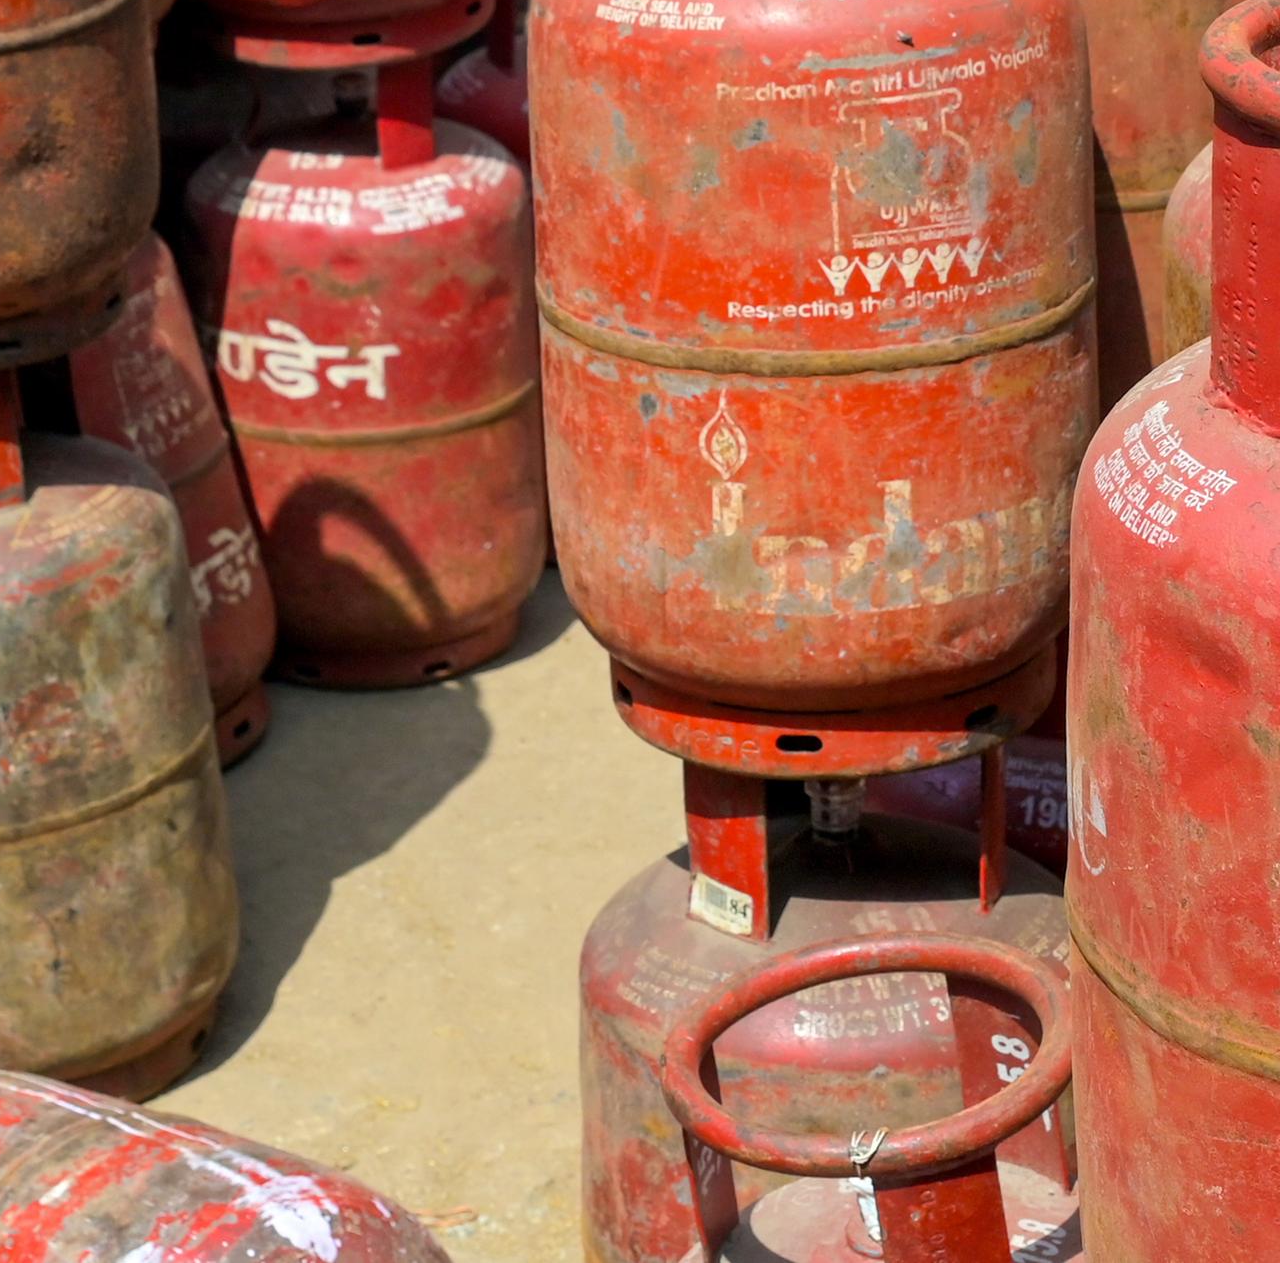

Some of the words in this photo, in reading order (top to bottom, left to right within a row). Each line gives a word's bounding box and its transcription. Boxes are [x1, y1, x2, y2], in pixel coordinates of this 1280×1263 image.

[595, 3, 640, 25] WEIGHT
[659, 15, 727, 31] DELIVERY
[650, 0, 682, 16] SEAL
[683, 2, 715, 17] AND
[906, 57, 987, 90] Ujjwala
[859, 294, 897, 314] the
[218, 318, 401, 400] ण्डेन
[1107, 447, 1132, 489] CHECK
[1144, 500, 1178, 528] AND
[930, 997, 951, 1022] 3
